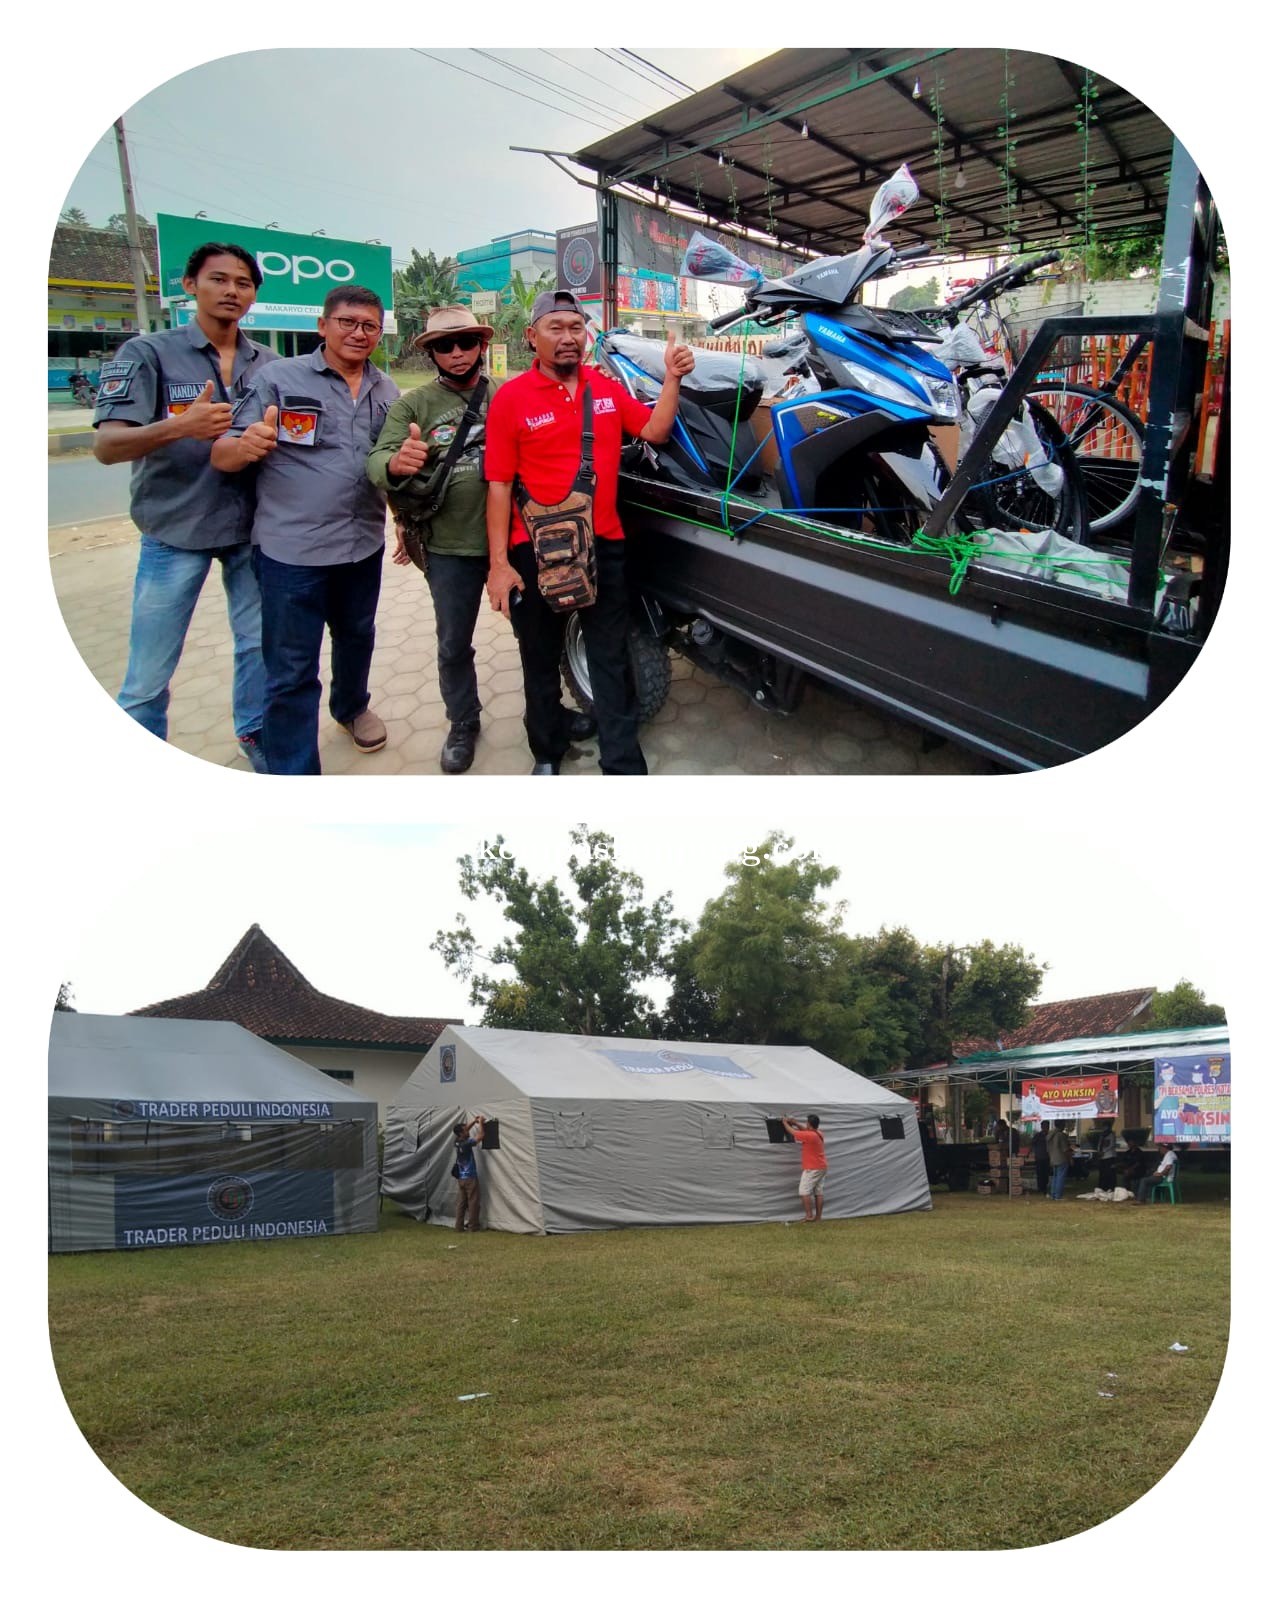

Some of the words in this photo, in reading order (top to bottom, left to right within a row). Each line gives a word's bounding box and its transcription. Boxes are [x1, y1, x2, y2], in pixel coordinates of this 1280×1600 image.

[256, 250, 355, 284] ppo
[816, 268, 840, 280] YAMAHA
[265, 304, 303, 313] MAKARYO
[304, 306, 321, 314] CELL
[818, 325, 846, 343] YAMAHA
[1042, 1089, 1059, 1099] AYO
[1062, 1087, 1096, 1098] VAKSIN
[140, 1102, 199, 1118] TRADER
[203, 1102, 251, 1117] PEDULI
[256, 1101, 330, 1116] INDONESIA
[1161, 1110, 1178, 1119] AYO
[1178, 1110, 1231, 1126] VAKSIN
[124, 1227, 188, 1246] TRADER
[192, 1224, 245, 1242] PEDULI
[250, 1219, 327, 1237] INDONESIA
